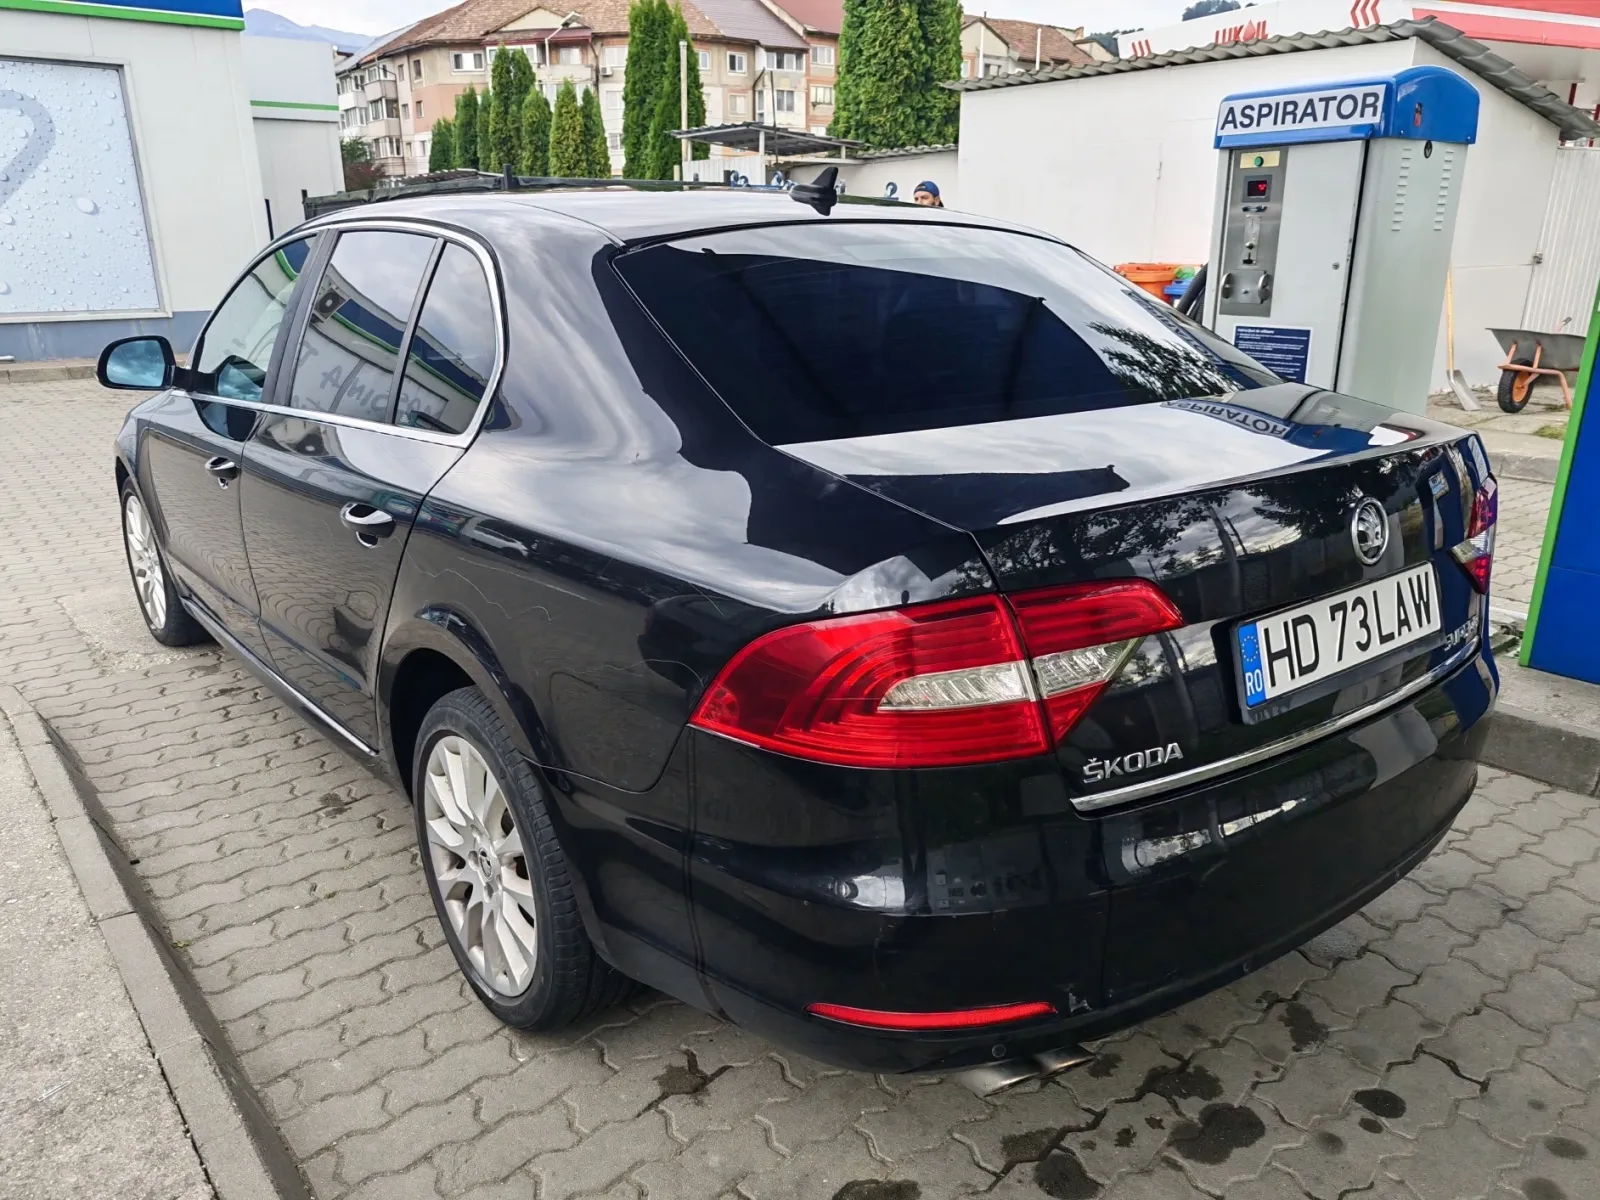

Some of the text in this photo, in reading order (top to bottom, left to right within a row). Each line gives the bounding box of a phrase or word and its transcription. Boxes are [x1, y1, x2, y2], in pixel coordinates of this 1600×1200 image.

[1220, 92, 1380, 131] ASPIRATOR
[1263, 613, 1320, 688] HD
[1245, 668, 1263, 697] RO
[1083, 742, 1184, 784] ŠKODA
